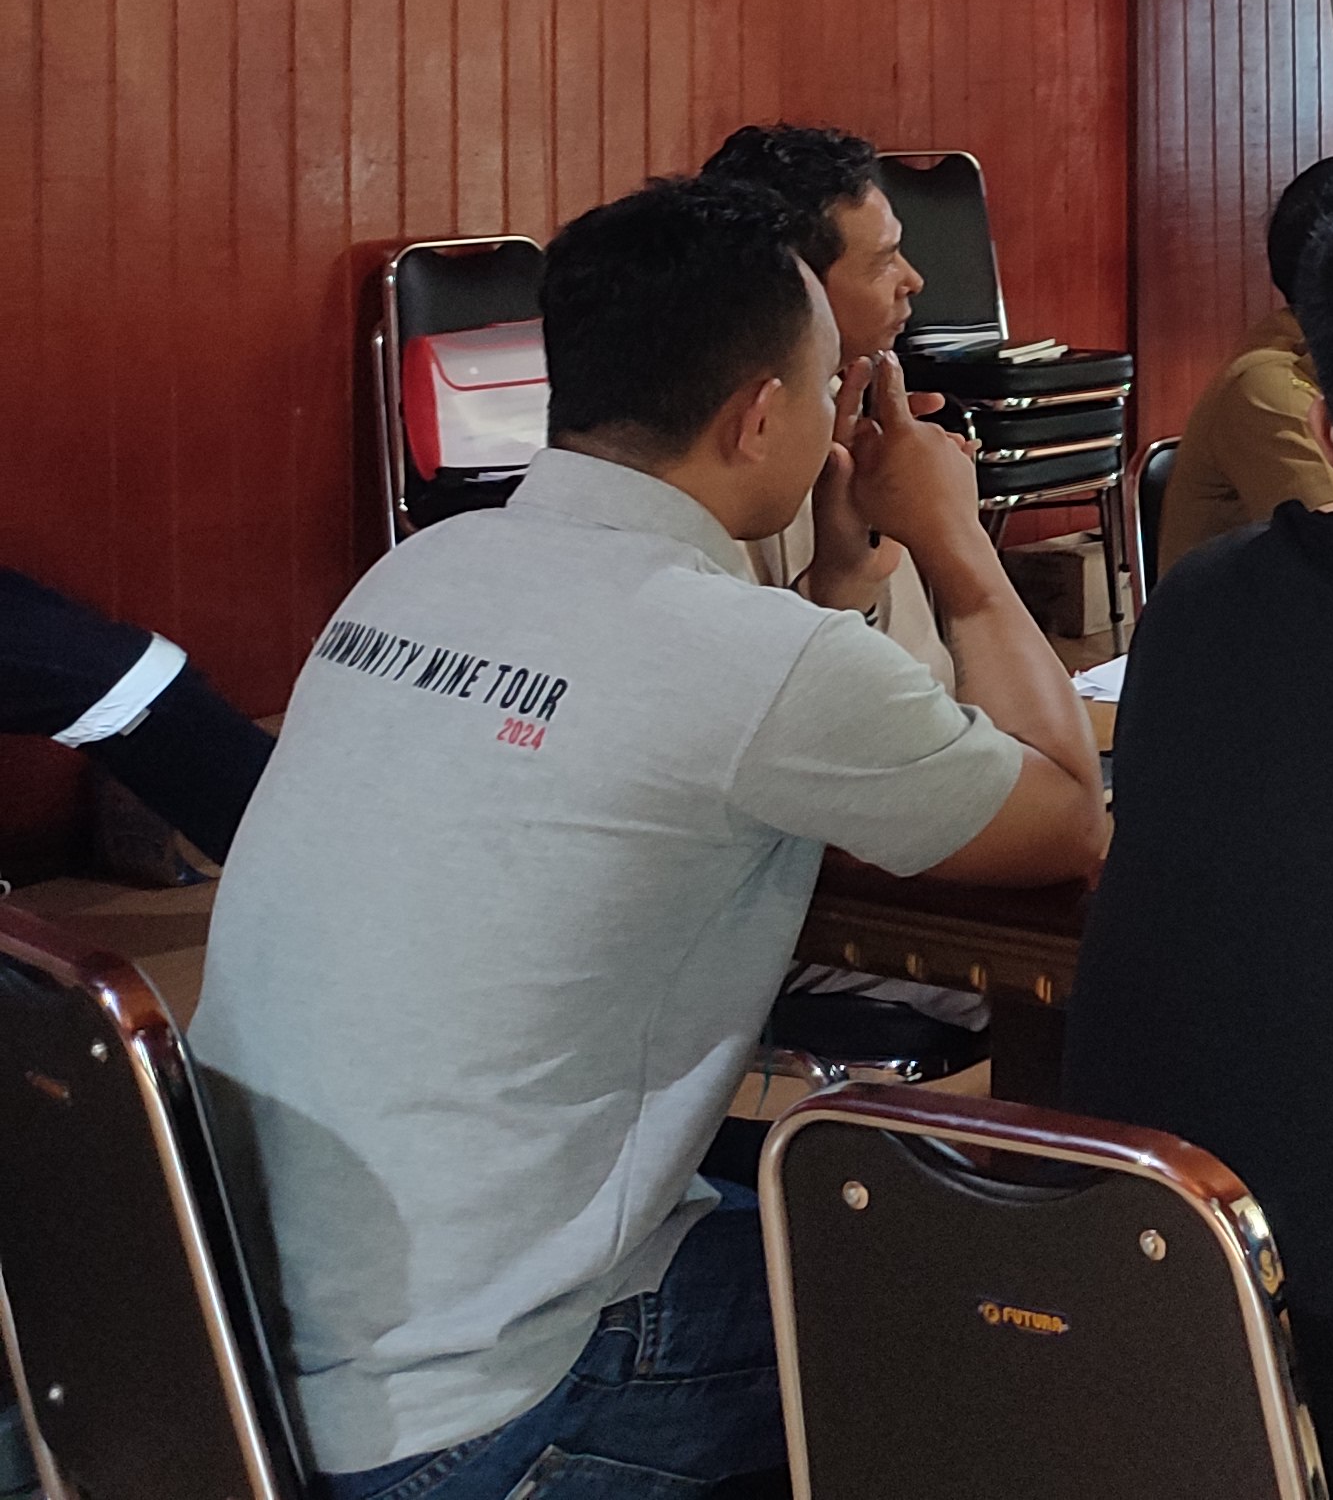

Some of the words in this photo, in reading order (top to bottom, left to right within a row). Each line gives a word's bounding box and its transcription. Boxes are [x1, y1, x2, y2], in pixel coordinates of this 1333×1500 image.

[412, 647, 491, 699] MINE
[482, 663, 569, 723] TOUR
[496, 717, 546, 750] 2024
